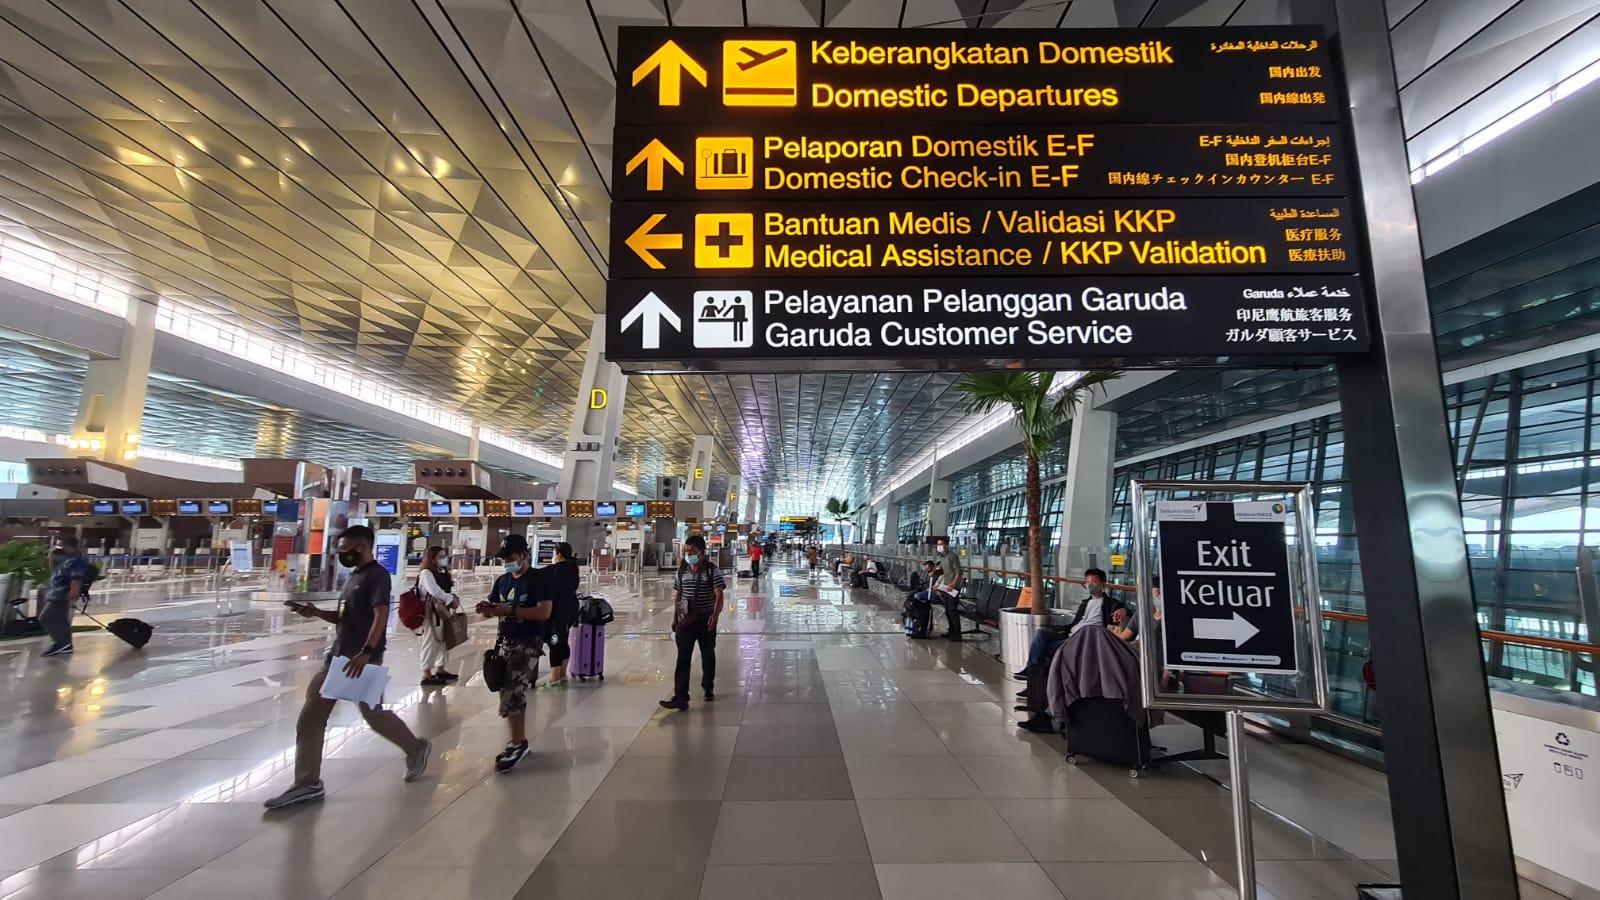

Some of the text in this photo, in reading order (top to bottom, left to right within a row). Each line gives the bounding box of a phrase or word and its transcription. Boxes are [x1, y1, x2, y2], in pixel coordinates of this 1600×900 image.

[811, 40, 1174, 71] Keberangkatan Domestik
[1268, 65, 1322, 79] 国内出发
[811, 83, 1119, 113] Domestic Departures
[1259, 91, 1326, 105] 国内線出発
[764, 133, 1095, 163] Pelaporan Domestik E-F
[1199, 135, 1223, 148] E-F
[764, 164, 1080, 190] Domestic Check-in E-F
[1310, 173, 1335, 185] E-F
[764, 209, 1176, 236] Bantuan Medis / Validasi KKP
[1285, 228, 1342, 242] 医疗服务
[764, 239, 1267, 269] Medical Assistance / KKP Validation
[764, 287, 1188, 319] Pelayanan Pelanggan Garuda
[1242, 288, 1285, 299] Garuda
[765, 320, 1133, 348] Garuda Customer Service
[590, 388, 608, 409] D
[695, 468, 703, 479] E
[1197, 539, 1252, 567] Exit
[1180, 579, 1275, 607] Keluar
